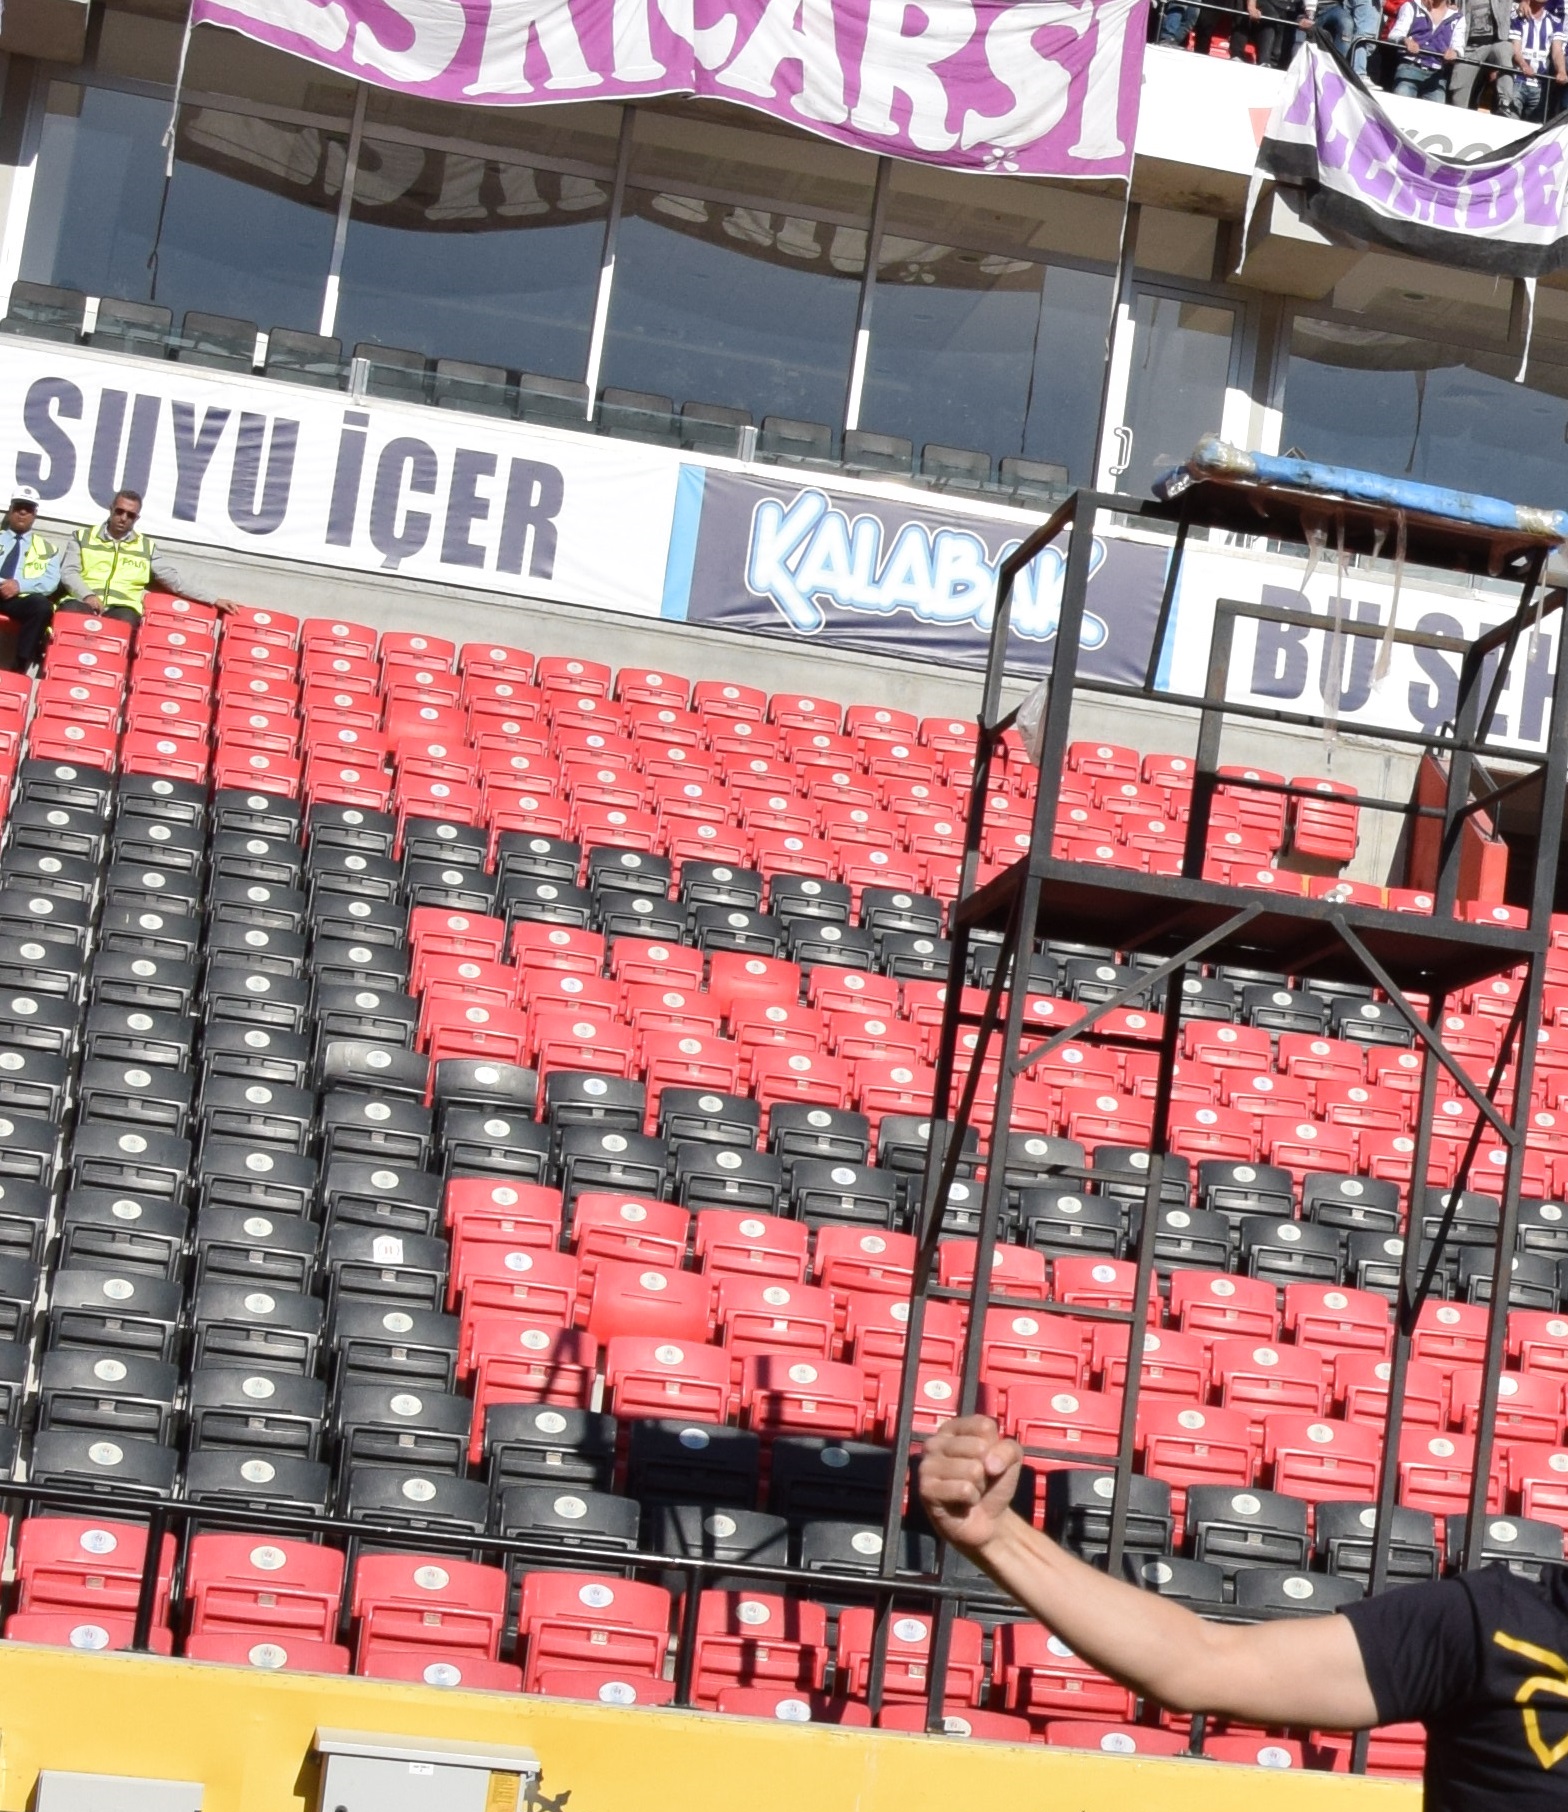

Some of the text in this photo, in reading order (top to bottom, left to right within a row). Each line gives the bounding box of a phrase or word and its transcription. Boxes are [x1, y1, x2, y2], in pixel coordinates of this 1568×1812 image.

[15, 376, 565, 580] SUYU İÇER
[1250, 583, 1382, 713] BU
